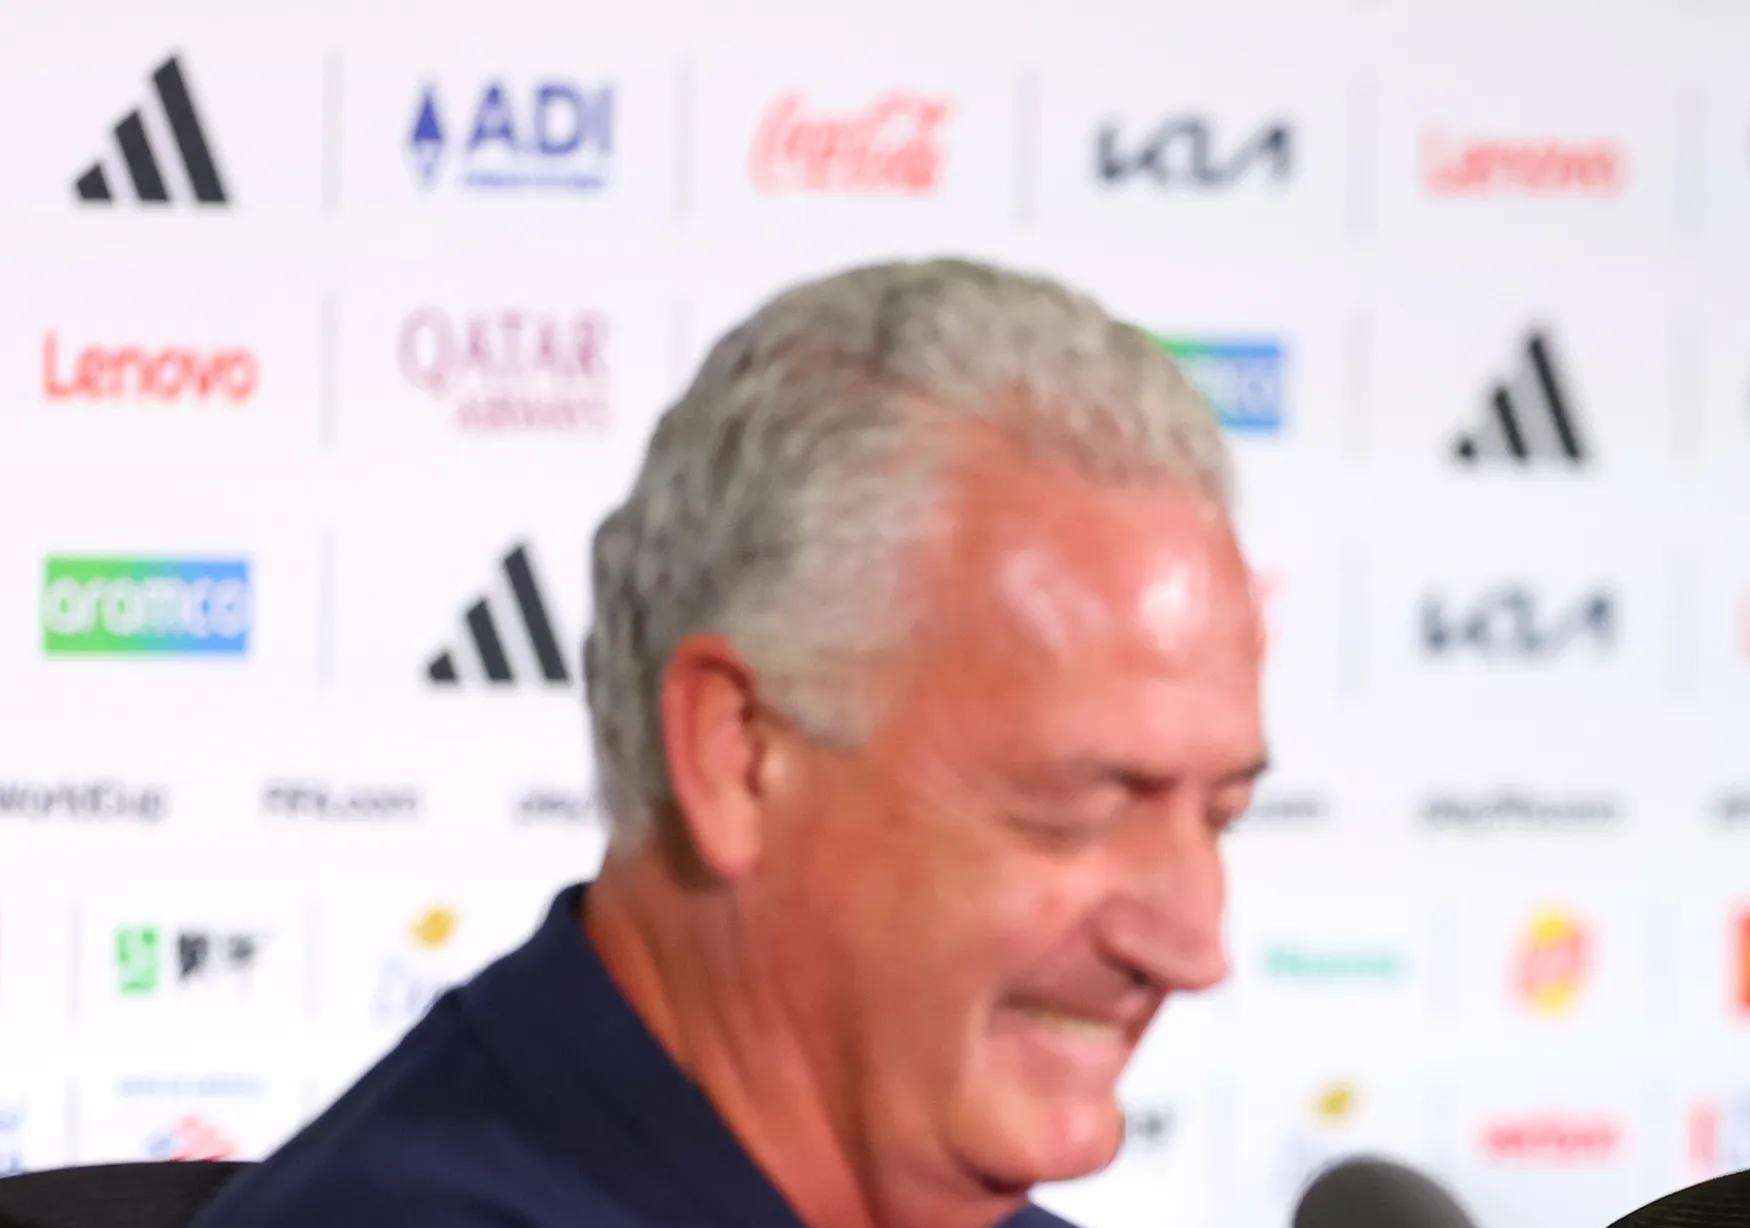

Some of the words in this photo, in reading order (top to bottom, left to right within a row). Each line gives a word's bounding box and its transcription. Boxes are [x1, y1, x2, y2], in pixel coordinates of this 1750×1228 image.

[465, 82, 616, 155] ADI
[42, 332, 258, 402] Lenovo
[400, 304, 610, 400] QATAR
